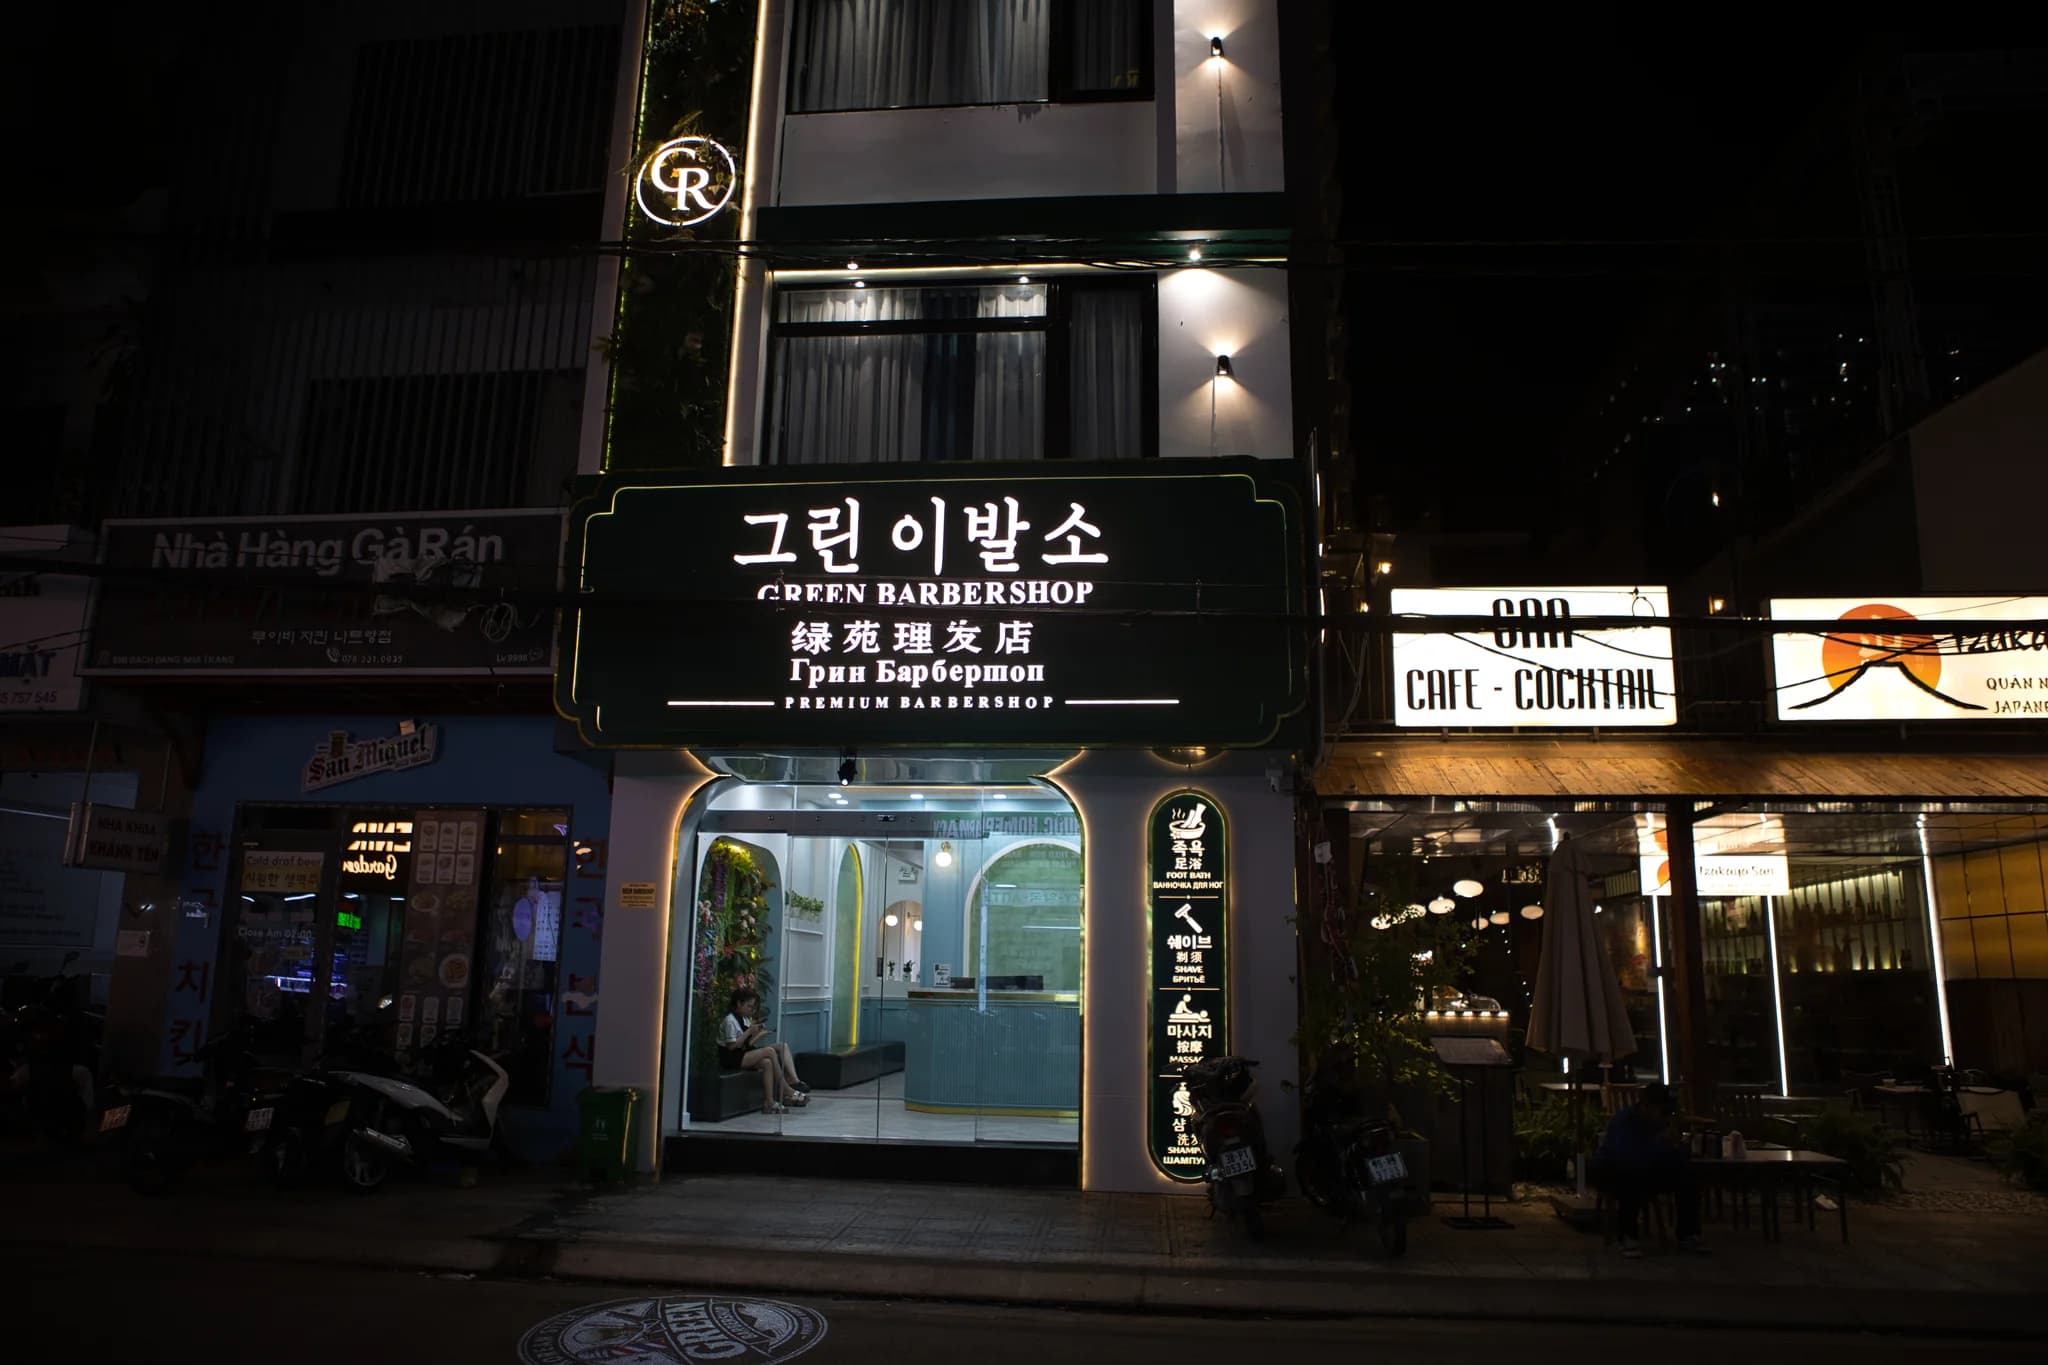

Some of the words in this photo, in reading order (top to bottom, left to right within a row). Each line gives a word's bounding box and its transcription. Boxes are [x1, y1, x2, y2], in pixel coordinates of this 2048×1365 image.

[733, 496, 860, 574] 그린
[891, 496, 1109, 576] 이발소
[152, 530, 229, 569] Nhà
[236, 528, 345, 577] Hàng
[352, 526, 411, 565] Gà
[417, 523, 504, 563] Rán
[756, 583, 867, 604] GREEN
[876, 580, 1095, 605] BARBERSHOP
[791, 619, 1035, 656] 绿苑理发店
[789, 657, 867, 689] Грин
[876, 659, 1046, 689] Барбершоп
[1406, 668, 1483, 710] CAFE
[1514, 667, 1666, 711] COCKTAIL
[784, 696, 889, 709] PREMIUM
[899, 695, 1054, 709] BARBERSHOP
[308, 757, 350, 784] San
[353, 727, 430, 770] Miguel
[1171, 840, 1206, 857] 족욕
[1174, 857, 1203, 870] 足浴
[1166, 871, 1188, 879] FOOT
[1189, 871, 1211, 879] BATH
[1167, 934, 1213, 950] 쉐이브
[1174, 966, 1204, 974] SHAVE
[1167, 1024, 1213, 1039] 마사지
[1176, 1040, 1203, 1054] 按摩
[1172, 1117, 1188, 1133] 샴
[664, 1301, 747, 1360] GREEN
